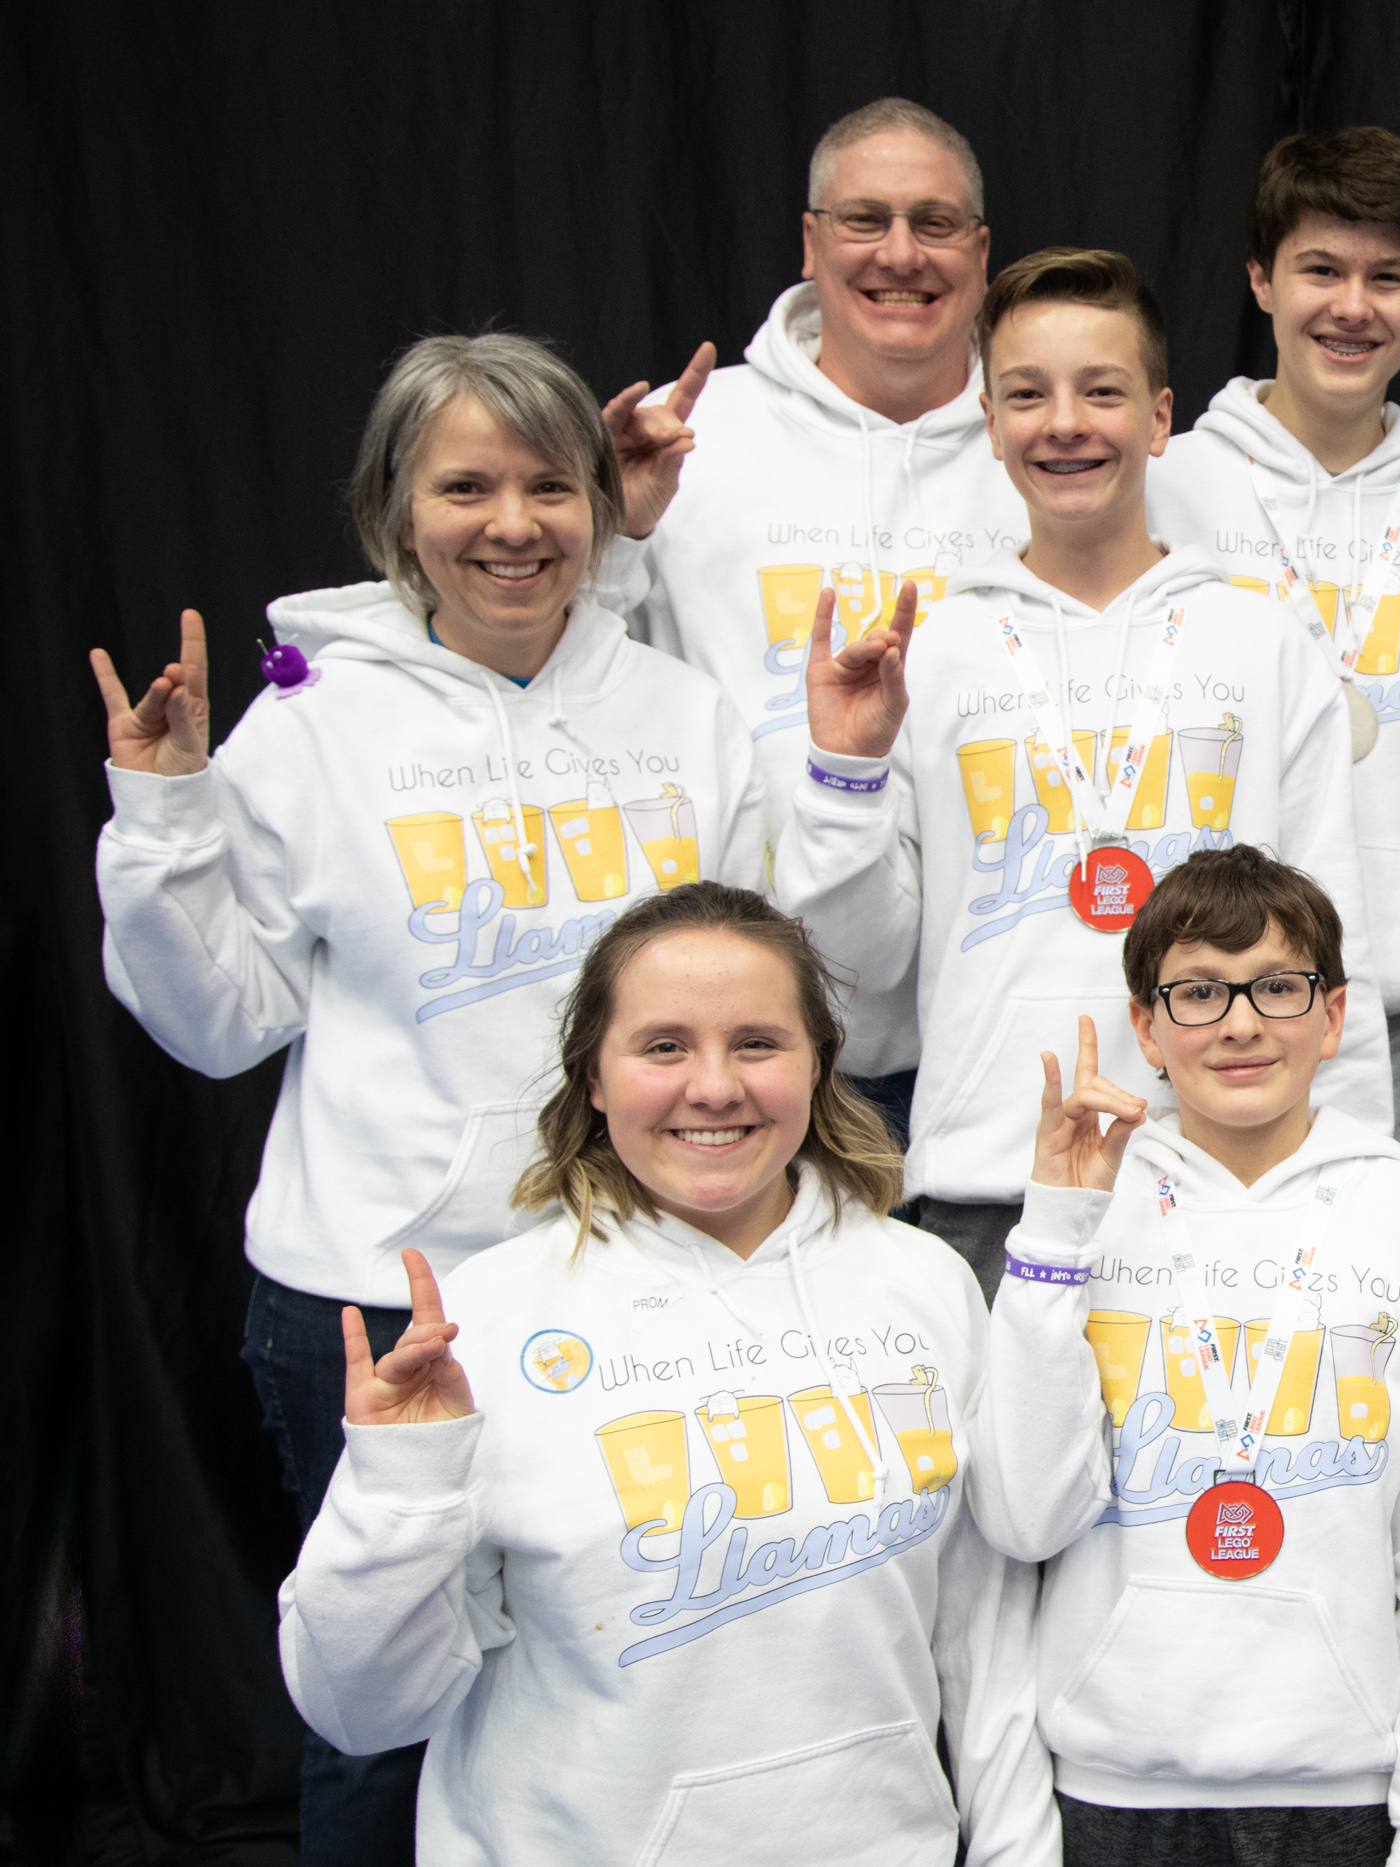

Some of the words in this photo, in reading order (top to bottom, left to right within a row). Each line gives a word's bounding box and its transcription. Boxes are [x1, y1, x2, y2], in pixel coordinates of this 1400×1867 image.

[766, 522, 840, 545] When
[903, 526, 975, 550] Gives
[1105, 674, 1183, 701] Gis
[1194, 673, 1245, 702] You
[389, 762, 475, 792] When
[486, 754, 534, 782] Lie
[544, 748, 621, 776] Gives
[627, 749, 681, 774] You
[1093, 884, 1130, 895] FIRST
[1091, 905, 1134, 915] LEAGUE
[1096, 895, 1127, 905] LEGO
[408, 878, 617, 989] Llam
[1021, 1266, 1035, 1278] FLL
[1089, 1255, 1172, 1286] When
[1205, 1260, 1238, 1288] ife
[1253, 1259, 1338, 1293] Gies
[598, 1354, 695, 1392] When
[707, 1338, 767, 1372] Life
[1214, 1525, 1256, 1538] FIRST
[1217, 1537, 1251, 1549] LEGO
[620, 1482, 951, 1627] Llamas
[1211, 1548, 1260, 1561] LEAGUE
